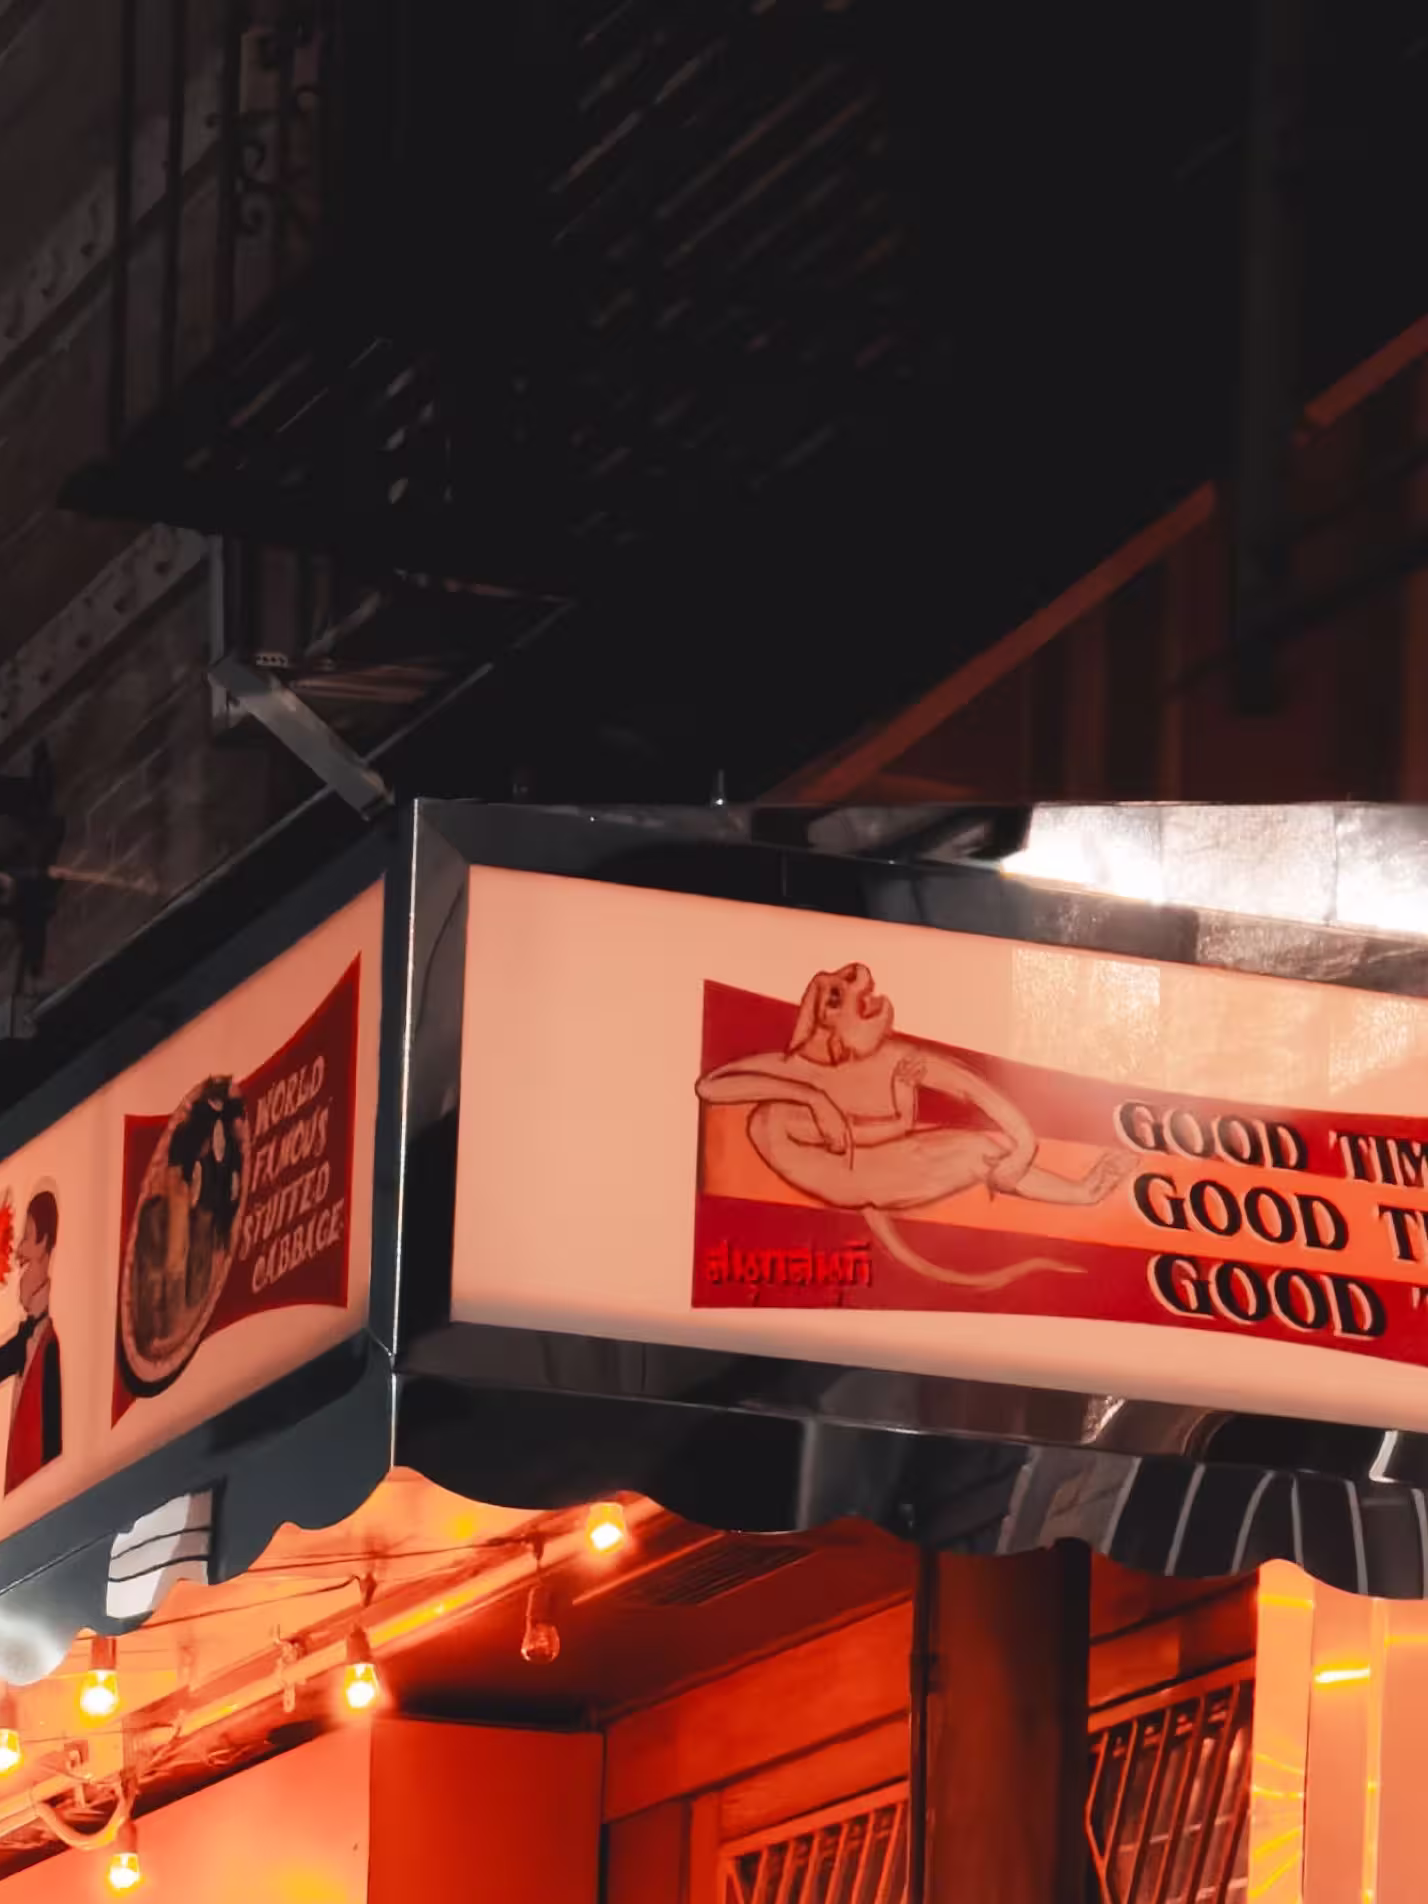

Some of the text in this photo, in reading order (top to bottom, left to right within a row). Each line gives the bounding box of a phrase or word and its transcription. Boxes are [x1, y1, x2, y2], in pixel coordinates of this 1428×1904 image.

[255, 1055, 325, 1138] WORLD
[1113, 1100, 1308, 1171] GOOD
[251, 1102, 330, 1193] FAMOUS
[1129, 1172, 1349, 1251] GOOD
[1147, 1253, 1387, 1340] GOOD
